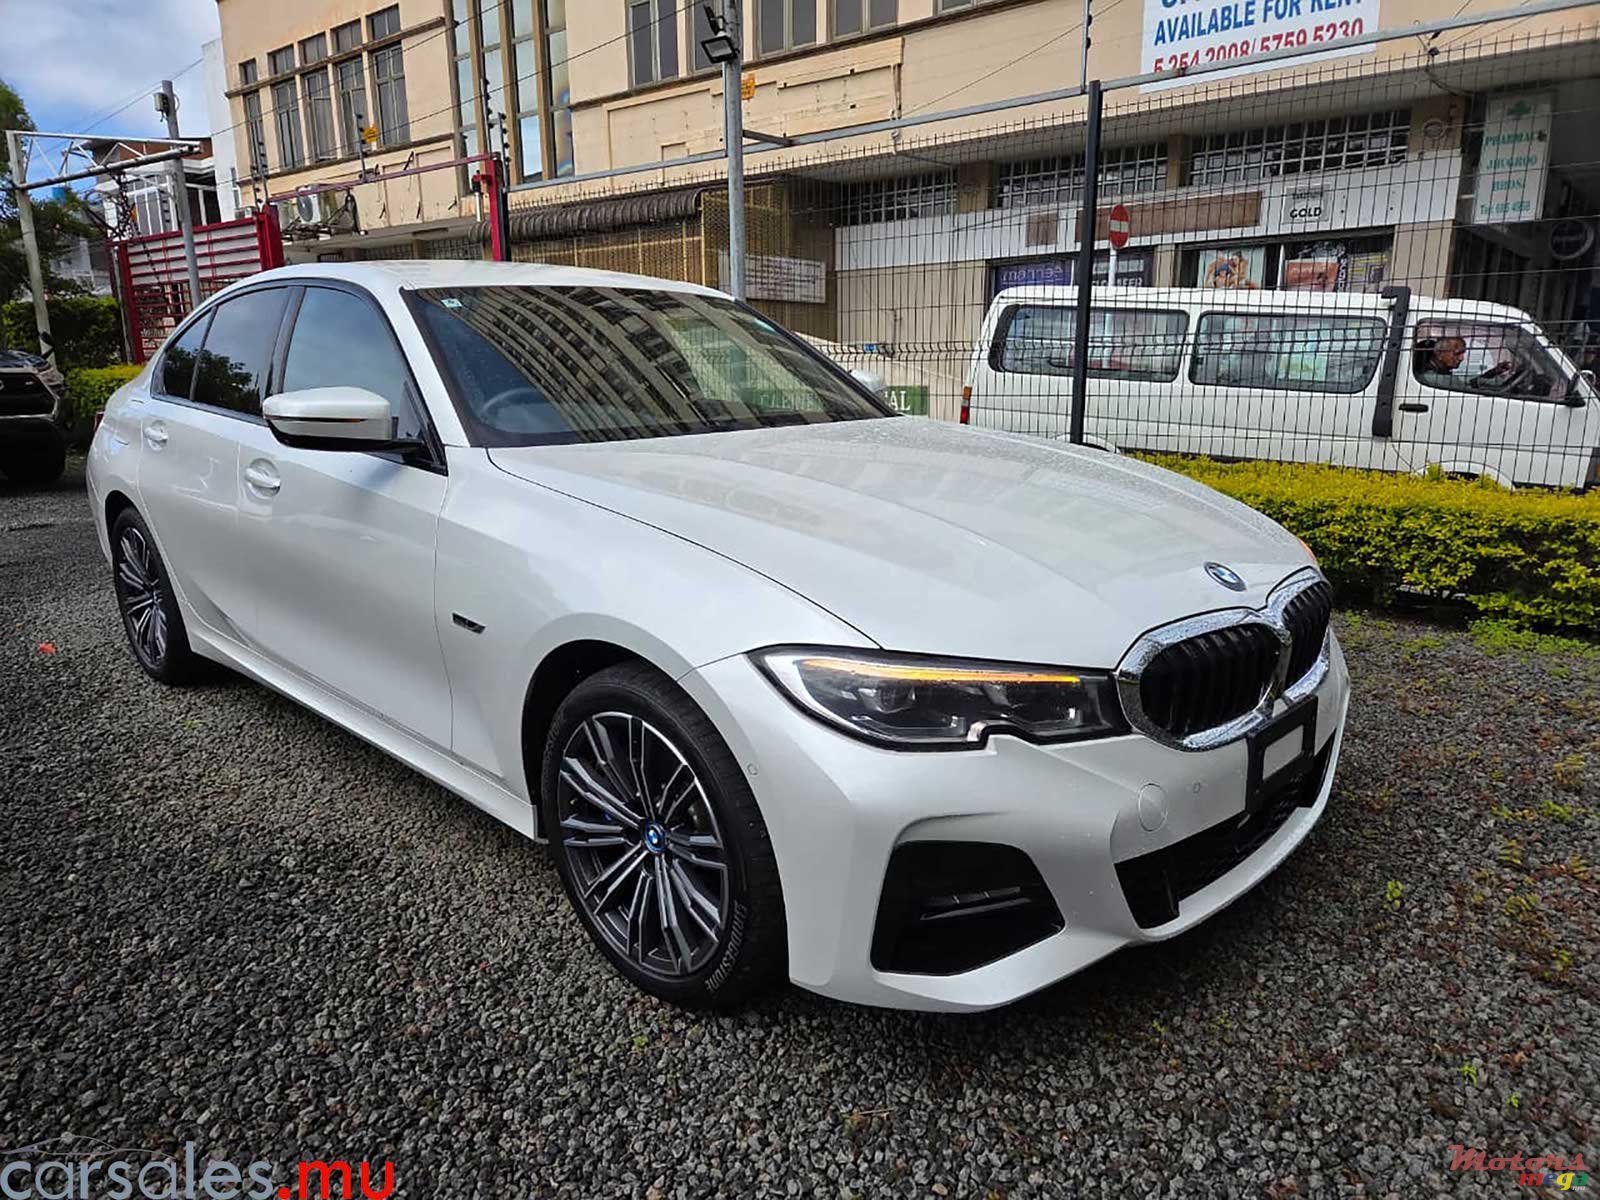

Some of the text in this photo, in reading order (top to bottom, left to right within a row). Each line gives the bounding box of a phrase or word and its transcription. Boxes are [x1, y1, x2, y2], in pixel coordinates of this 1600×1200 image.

[1154, 2, 1255, 46] AVAILABLE
[1263, 0, 1301, 23] FOR
[1290, 207, 1322, 219] GOLD
